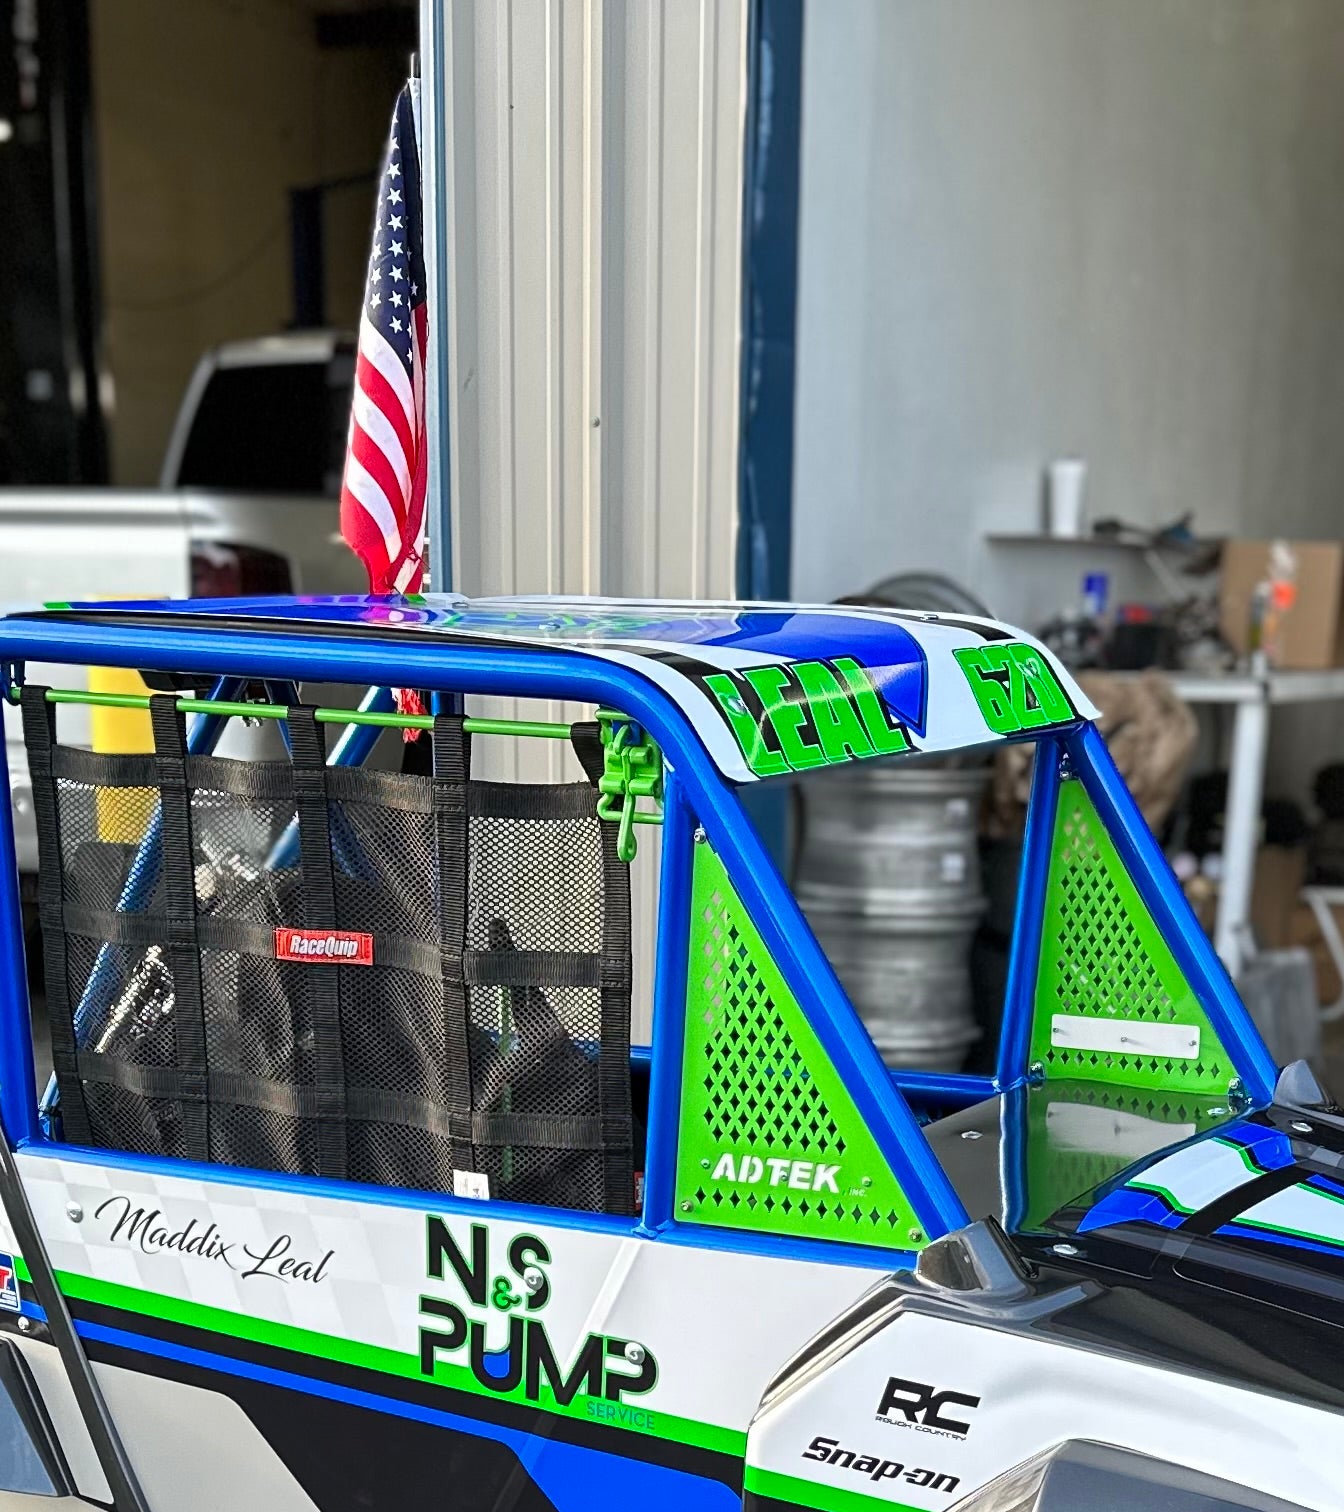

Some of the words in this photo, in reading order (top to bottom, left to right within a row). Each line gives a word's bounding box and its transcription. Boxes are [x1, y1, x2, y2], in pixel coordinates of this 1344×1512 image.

[953, 642, 1074, 734] 620
[702, 657, 909, 777] LEAL
[290, 934, 359, 957] RaceQuip
[711, 1153, 842, 1194] ADTEK
[95, 1195, 234, 1262] Maddix
[242, 1234, 336, 1284] Leal
[418, 1294, 659, 1407] PUMP
[586, 1401, 656, 1430] SERVICE
[875, 1415, 912, 1429] ROUGH
[915, 1425, 966, 1441] COUNTRY
[877, 1377, 981, 1434] RC
[802, 1436, 960, 1493] Snap-on
